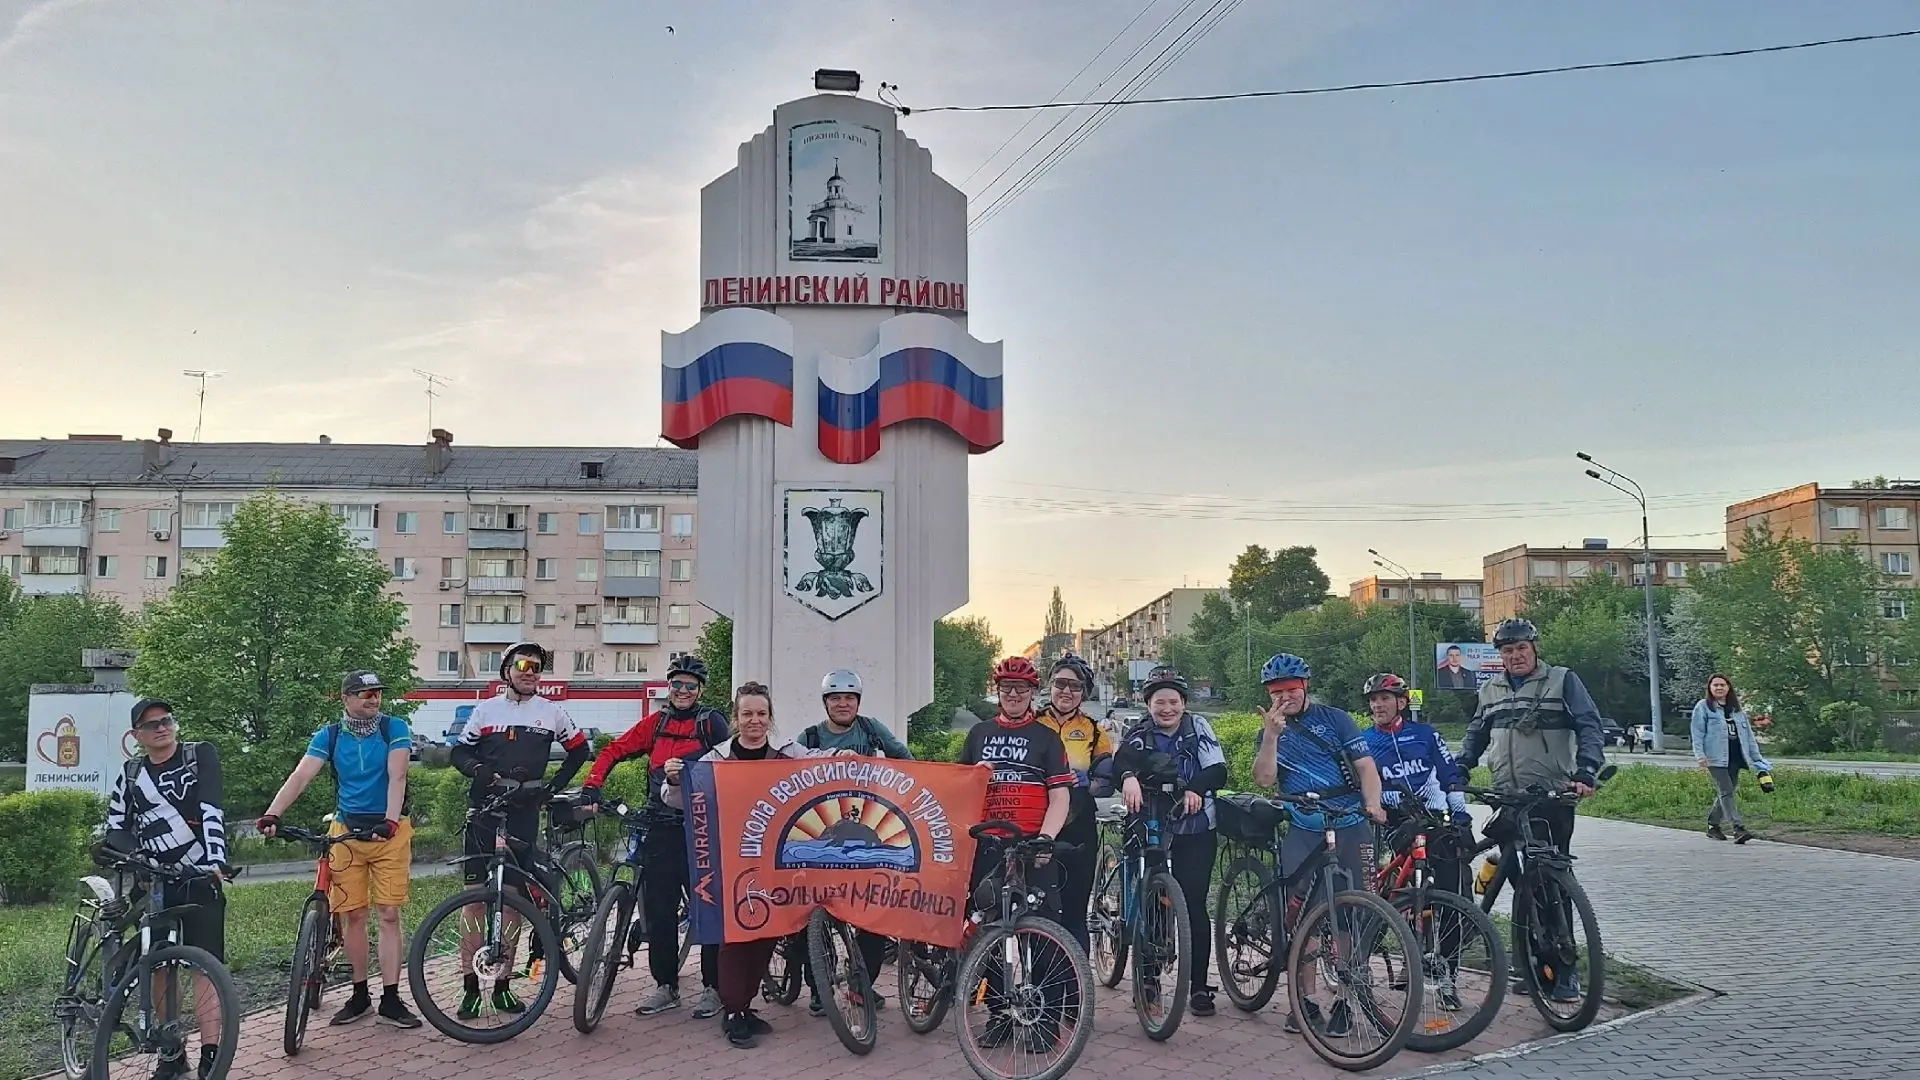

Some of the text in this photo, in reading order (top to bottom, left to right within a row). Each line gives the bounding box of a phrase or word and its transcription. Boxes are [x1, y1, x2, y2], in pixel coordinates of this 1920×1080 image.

[703, 271, 965, 310] ЛЕНИНСКИЙ РАЙОН
[983, 735, 1029, 746] I AM NOT
[982, 746, 1028, 760] SLOW
[1382, 758, 1430, 780] ASML
[34, 770, 100, 783] ЛЕНИНСКИЙ
[1006, 772, 1022, 781] ON
[986, 797, 1021, 807] SAVING
[989, 810, 1017, 819] MODE
[690, 791, 711, 870] EVRAZEN
